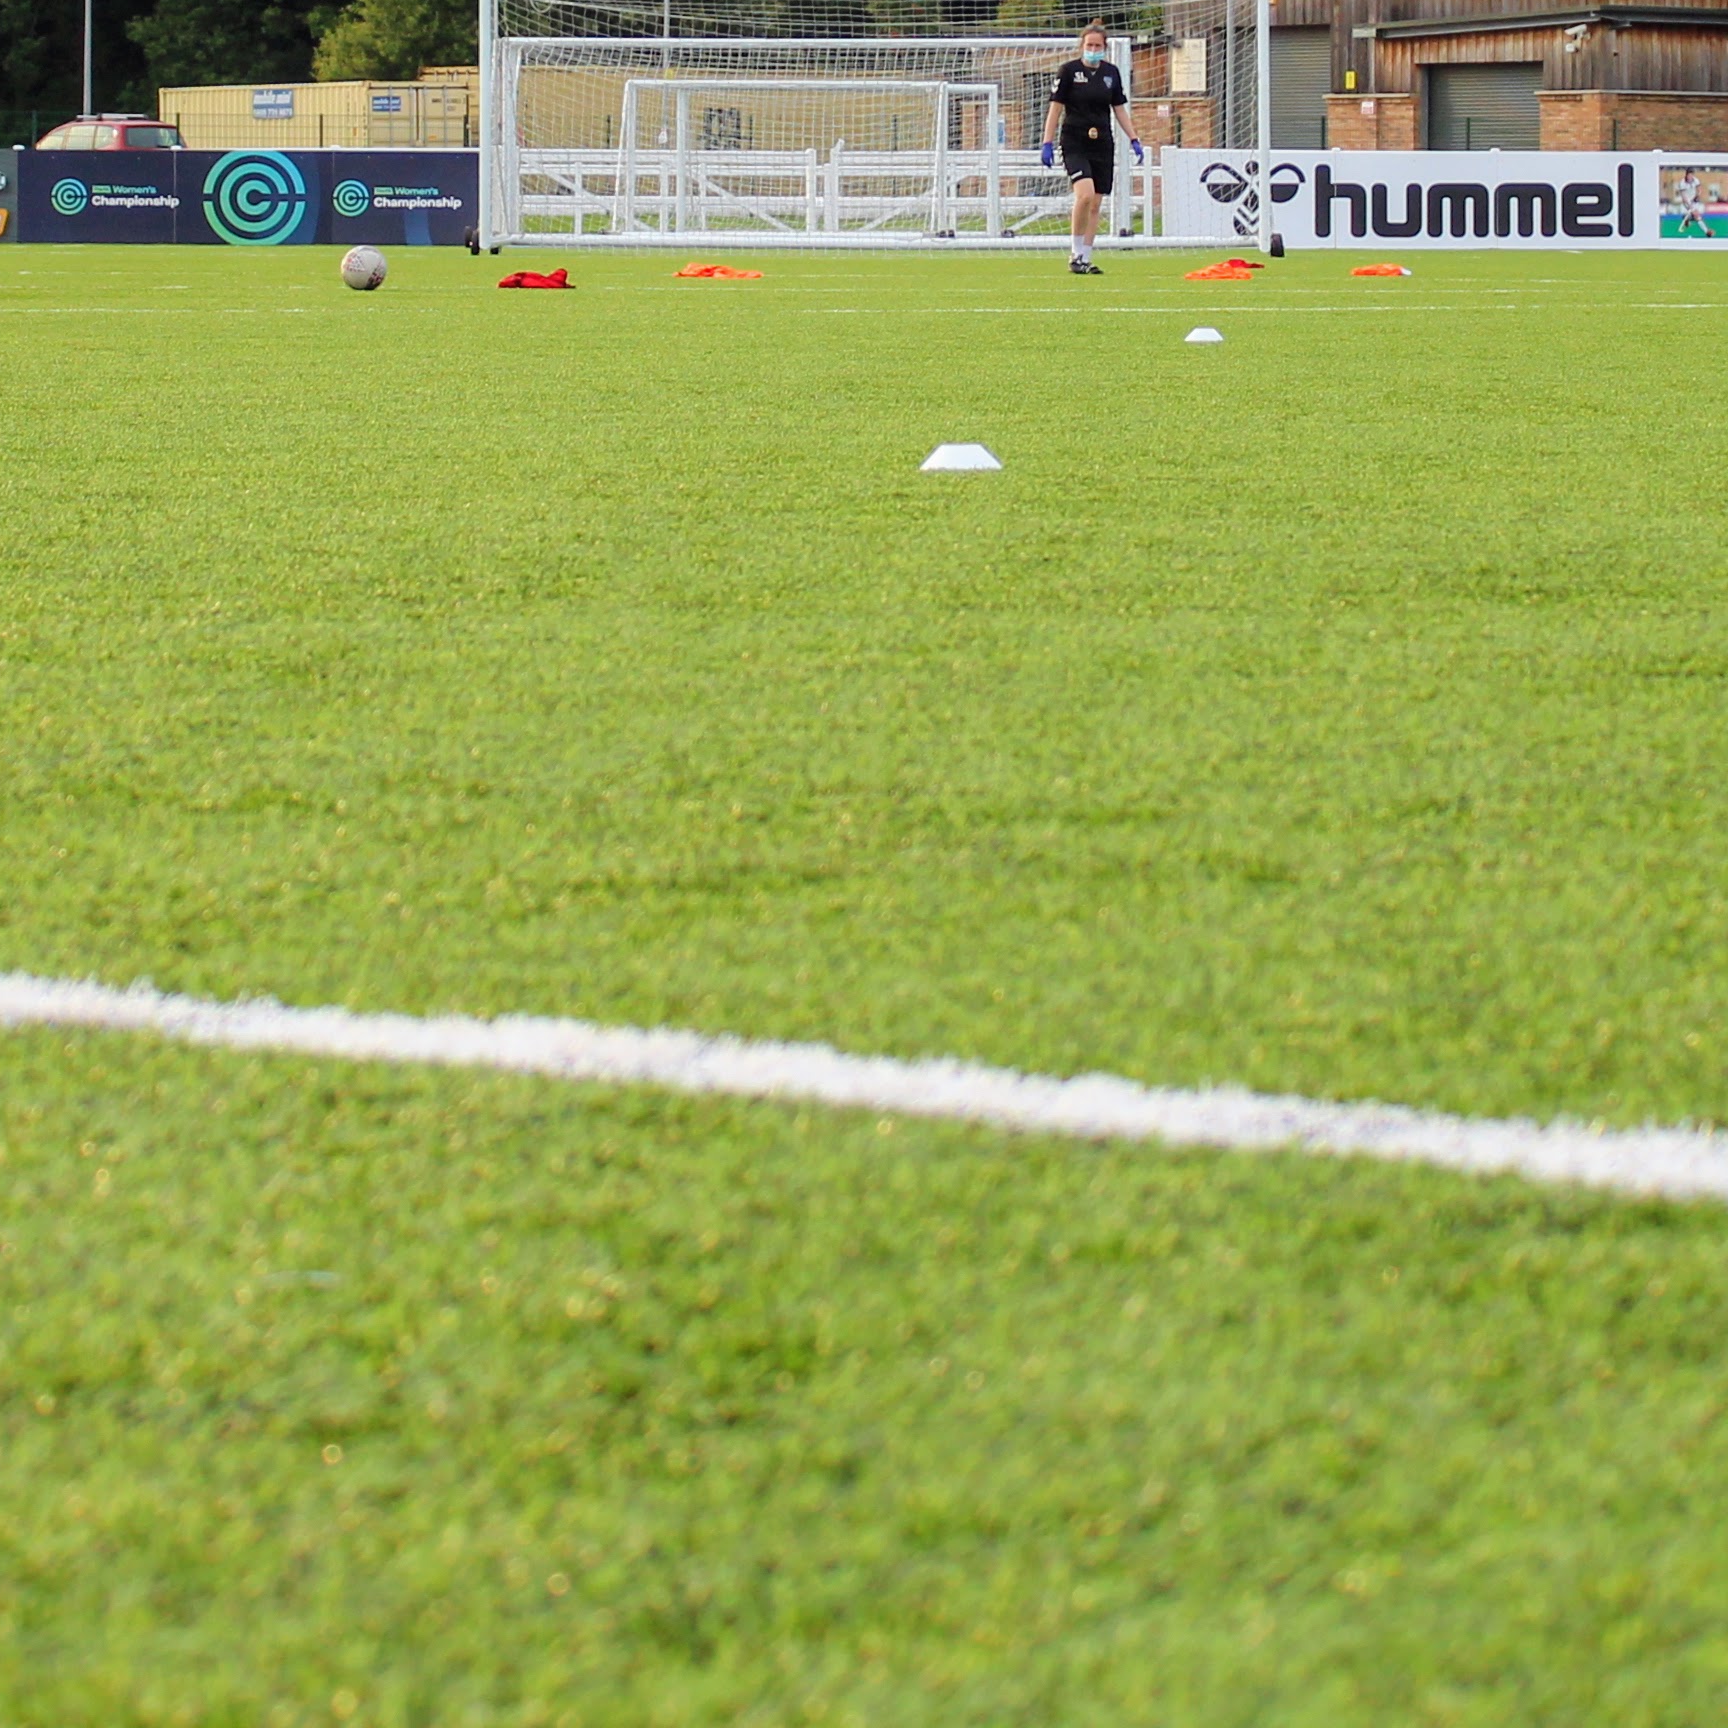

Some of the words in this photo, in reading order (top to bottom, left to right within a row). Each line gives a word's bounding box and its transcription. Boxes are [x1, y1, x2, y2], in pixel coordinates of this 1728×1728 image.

[112, 185, 157, 194] Women's
[395, 187, 439, 196] Women's
[92, 194, 180, 209] Championship
[373, 196, 462, 210] Championship
[1314, 163, 1635, 238] hummel
